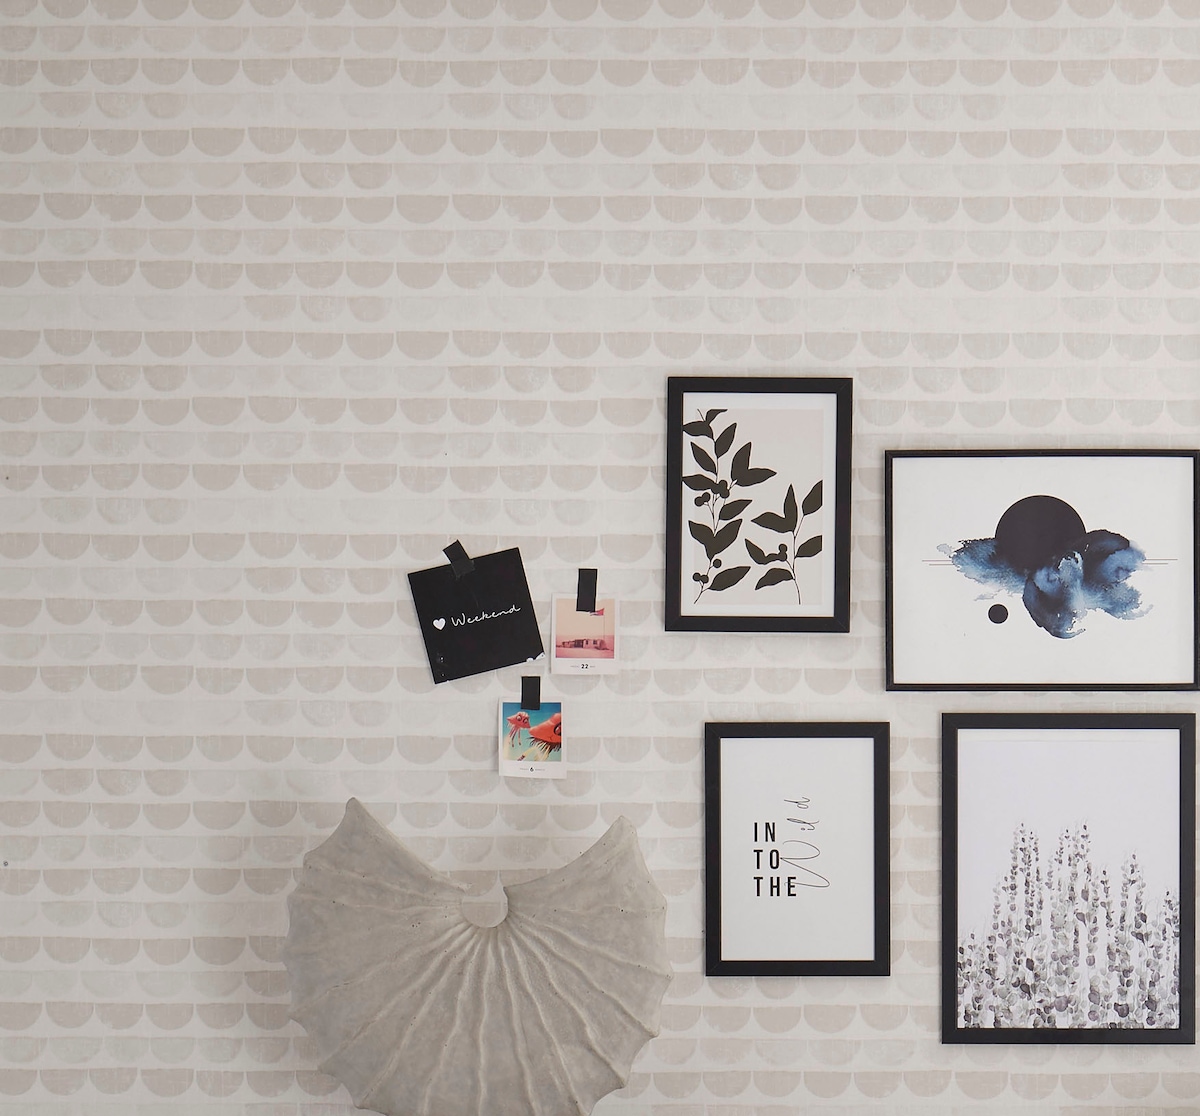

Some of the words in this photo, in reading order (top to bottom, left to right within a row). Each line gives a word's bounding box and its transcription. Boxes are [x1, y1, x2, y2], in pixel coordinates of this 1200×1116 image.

[451, 604, 521, 627] Weekend
[753, 822, 776, 843] IN
[780, 796, 830, 888] Wild
[753, 849, 780, 870] TO
[753, 876, 797, 897] THE
